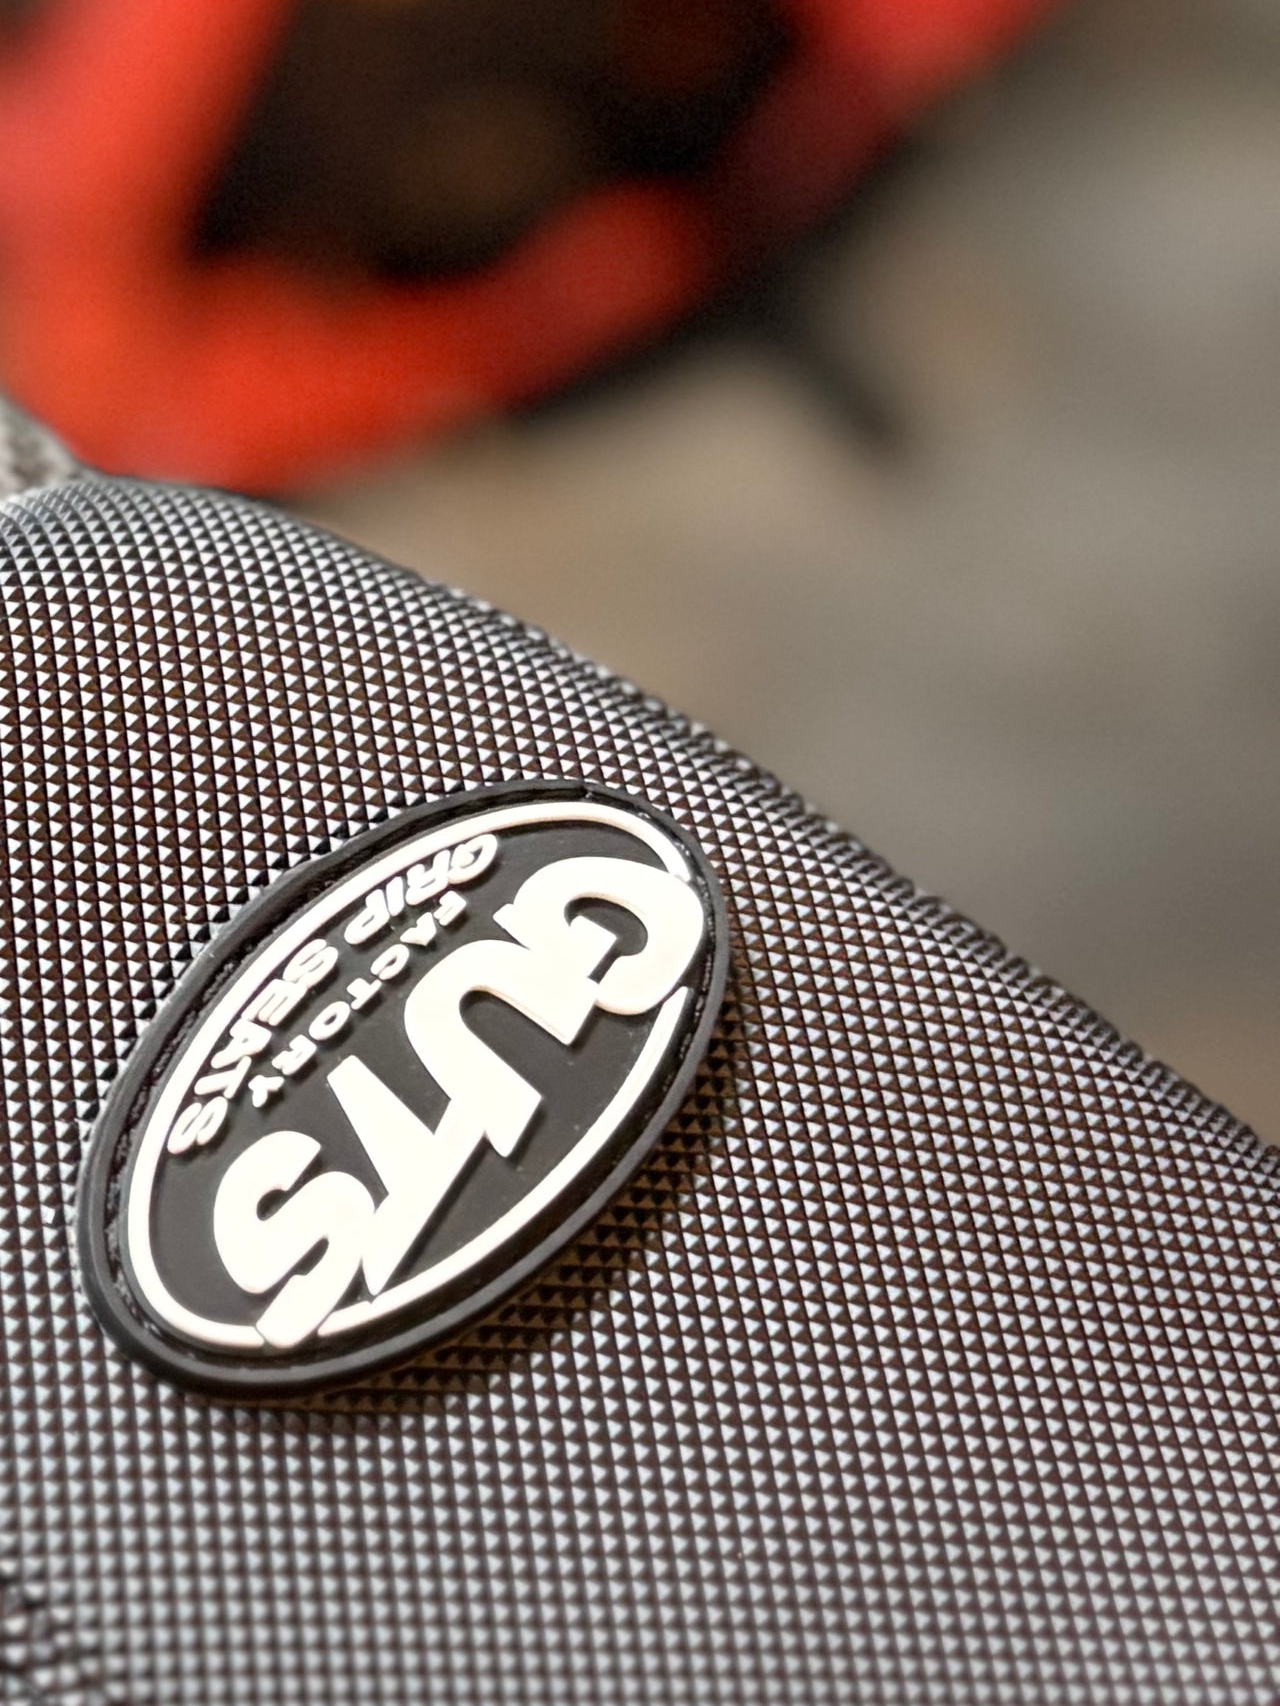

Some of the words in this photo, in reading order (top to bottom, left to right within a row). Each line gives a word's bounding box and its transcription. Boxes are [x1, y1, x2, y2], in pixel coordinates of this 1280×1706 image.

[341, 833, 500, 937] GRIP
[167, 938, 339, 1156] SEATS
[213, 856, 704, 1348] GUTS
[244, 890, 467, 1110] FACTORY
